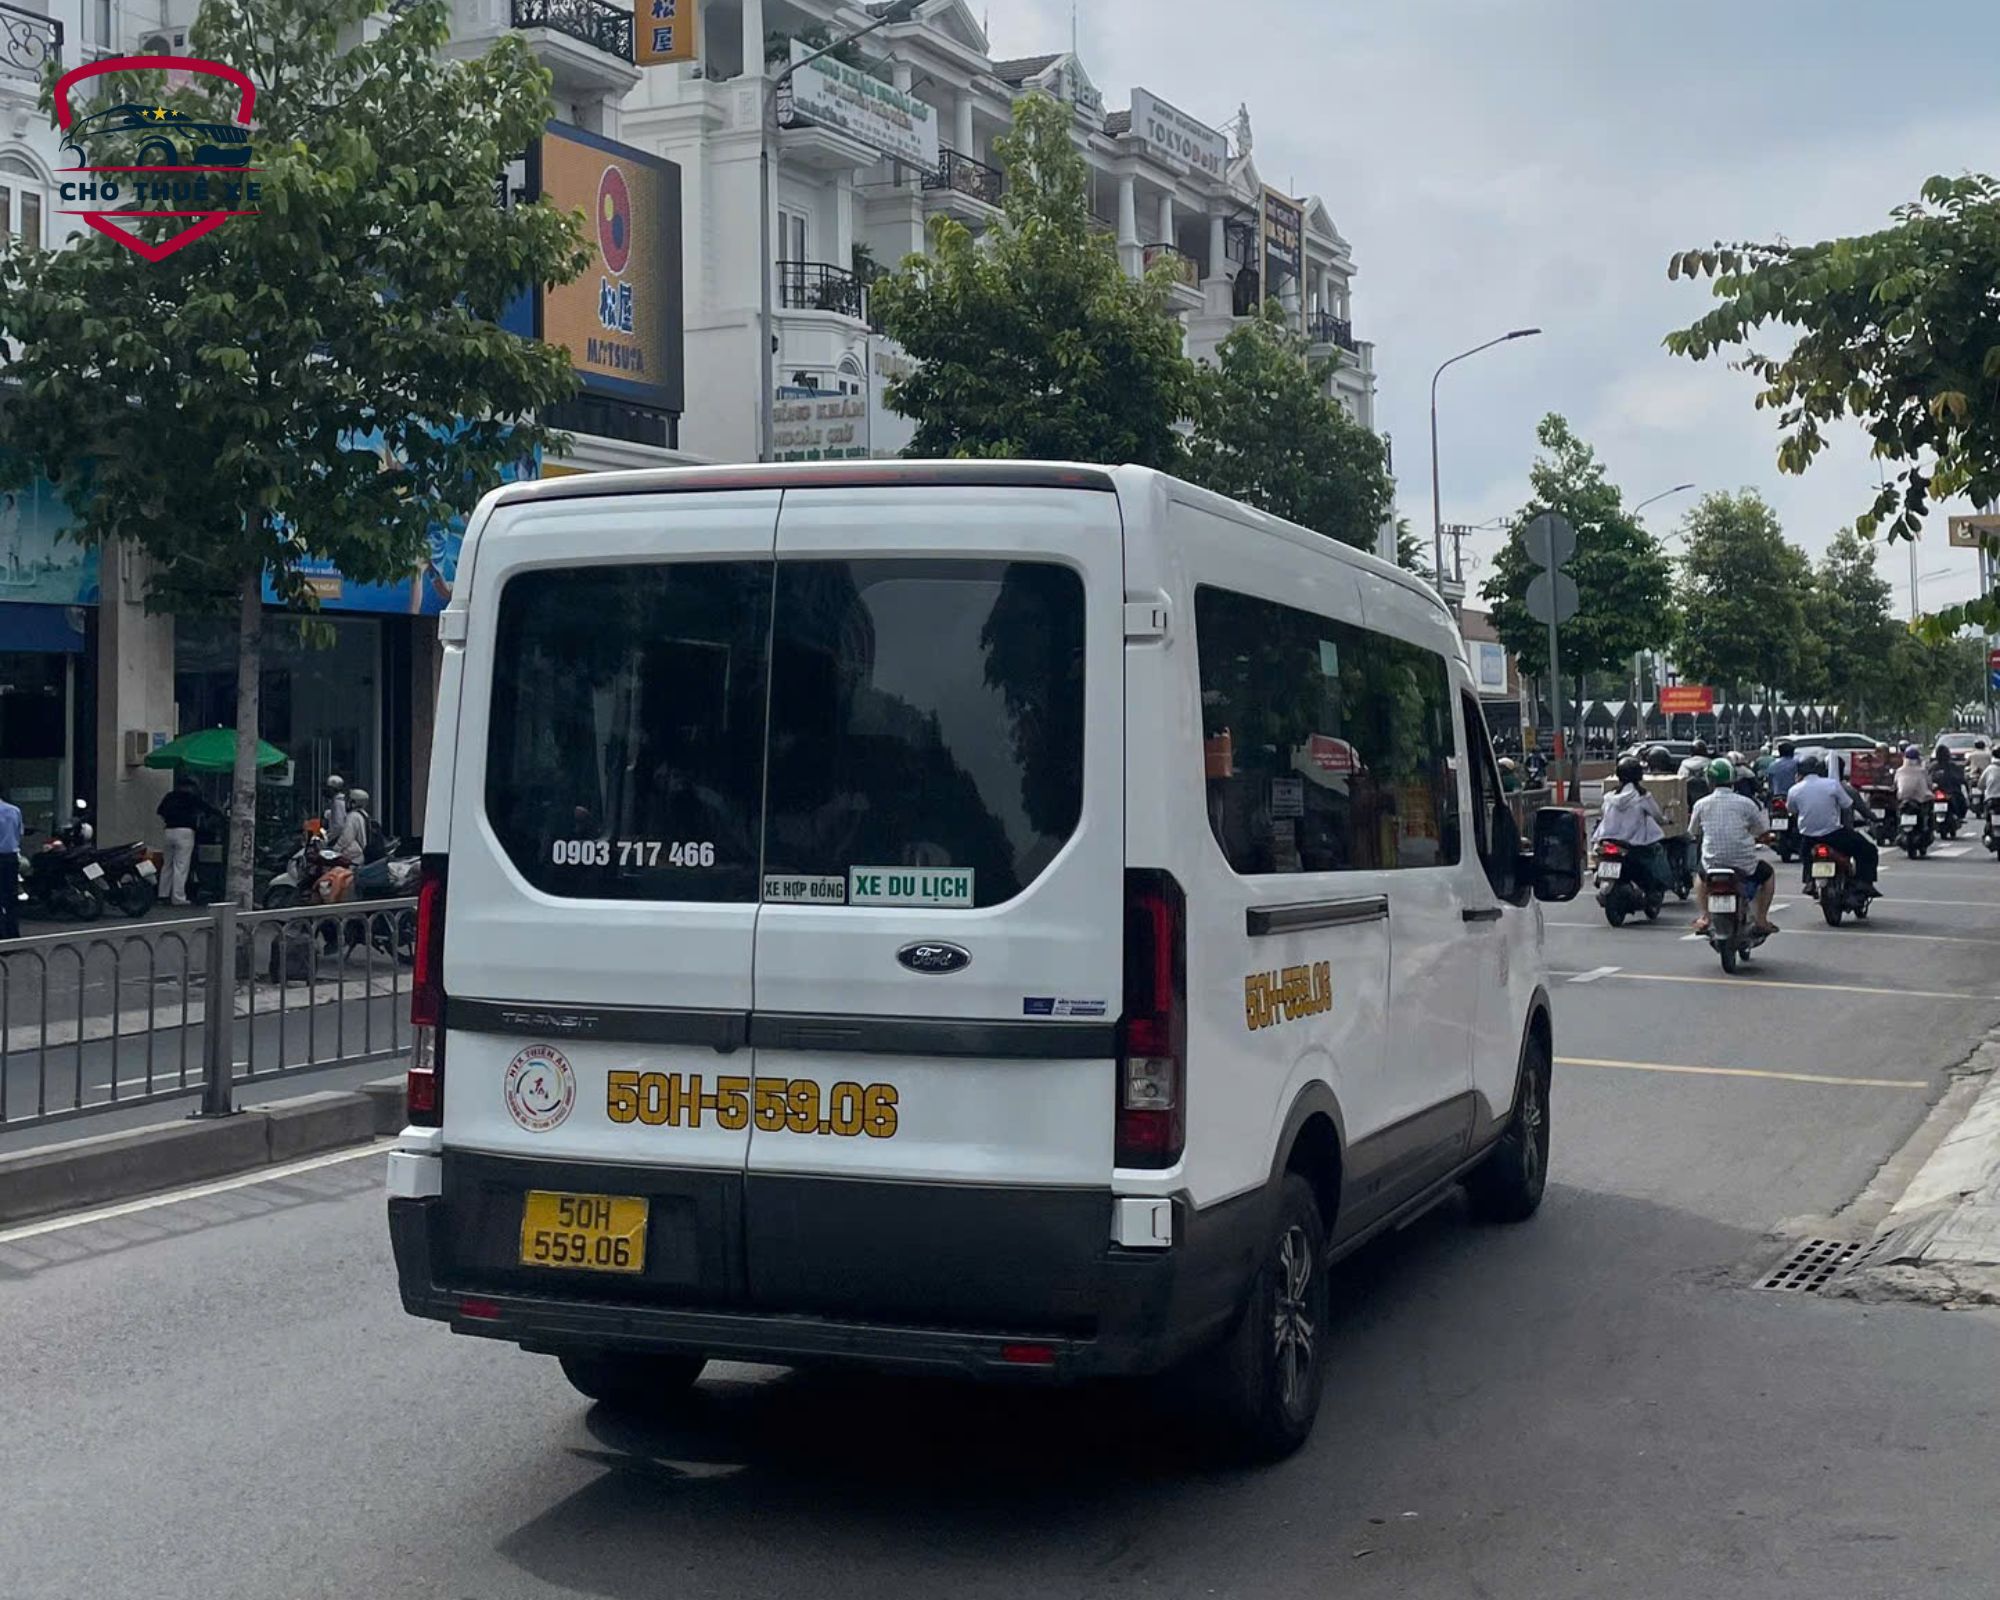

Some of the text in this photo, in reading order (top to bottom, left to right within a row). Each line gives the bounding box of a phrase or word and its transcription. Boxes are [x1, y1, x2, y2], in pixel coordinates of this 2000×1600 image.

[599, 276, 633, 334] 松屋
[553, 839, 715, 867] 0903 717 466
[765, 881, 780, 897] XE
[783, 880, 807, 900] HỢP
[855, 875, 968, 901] XE DU LỊCH
[502, 1012, 599, 1028] TRANSIT
[607, 1070, 898, 1139] 50H-559.06
[534, 1197, 630, 1267] 50H 559.06
